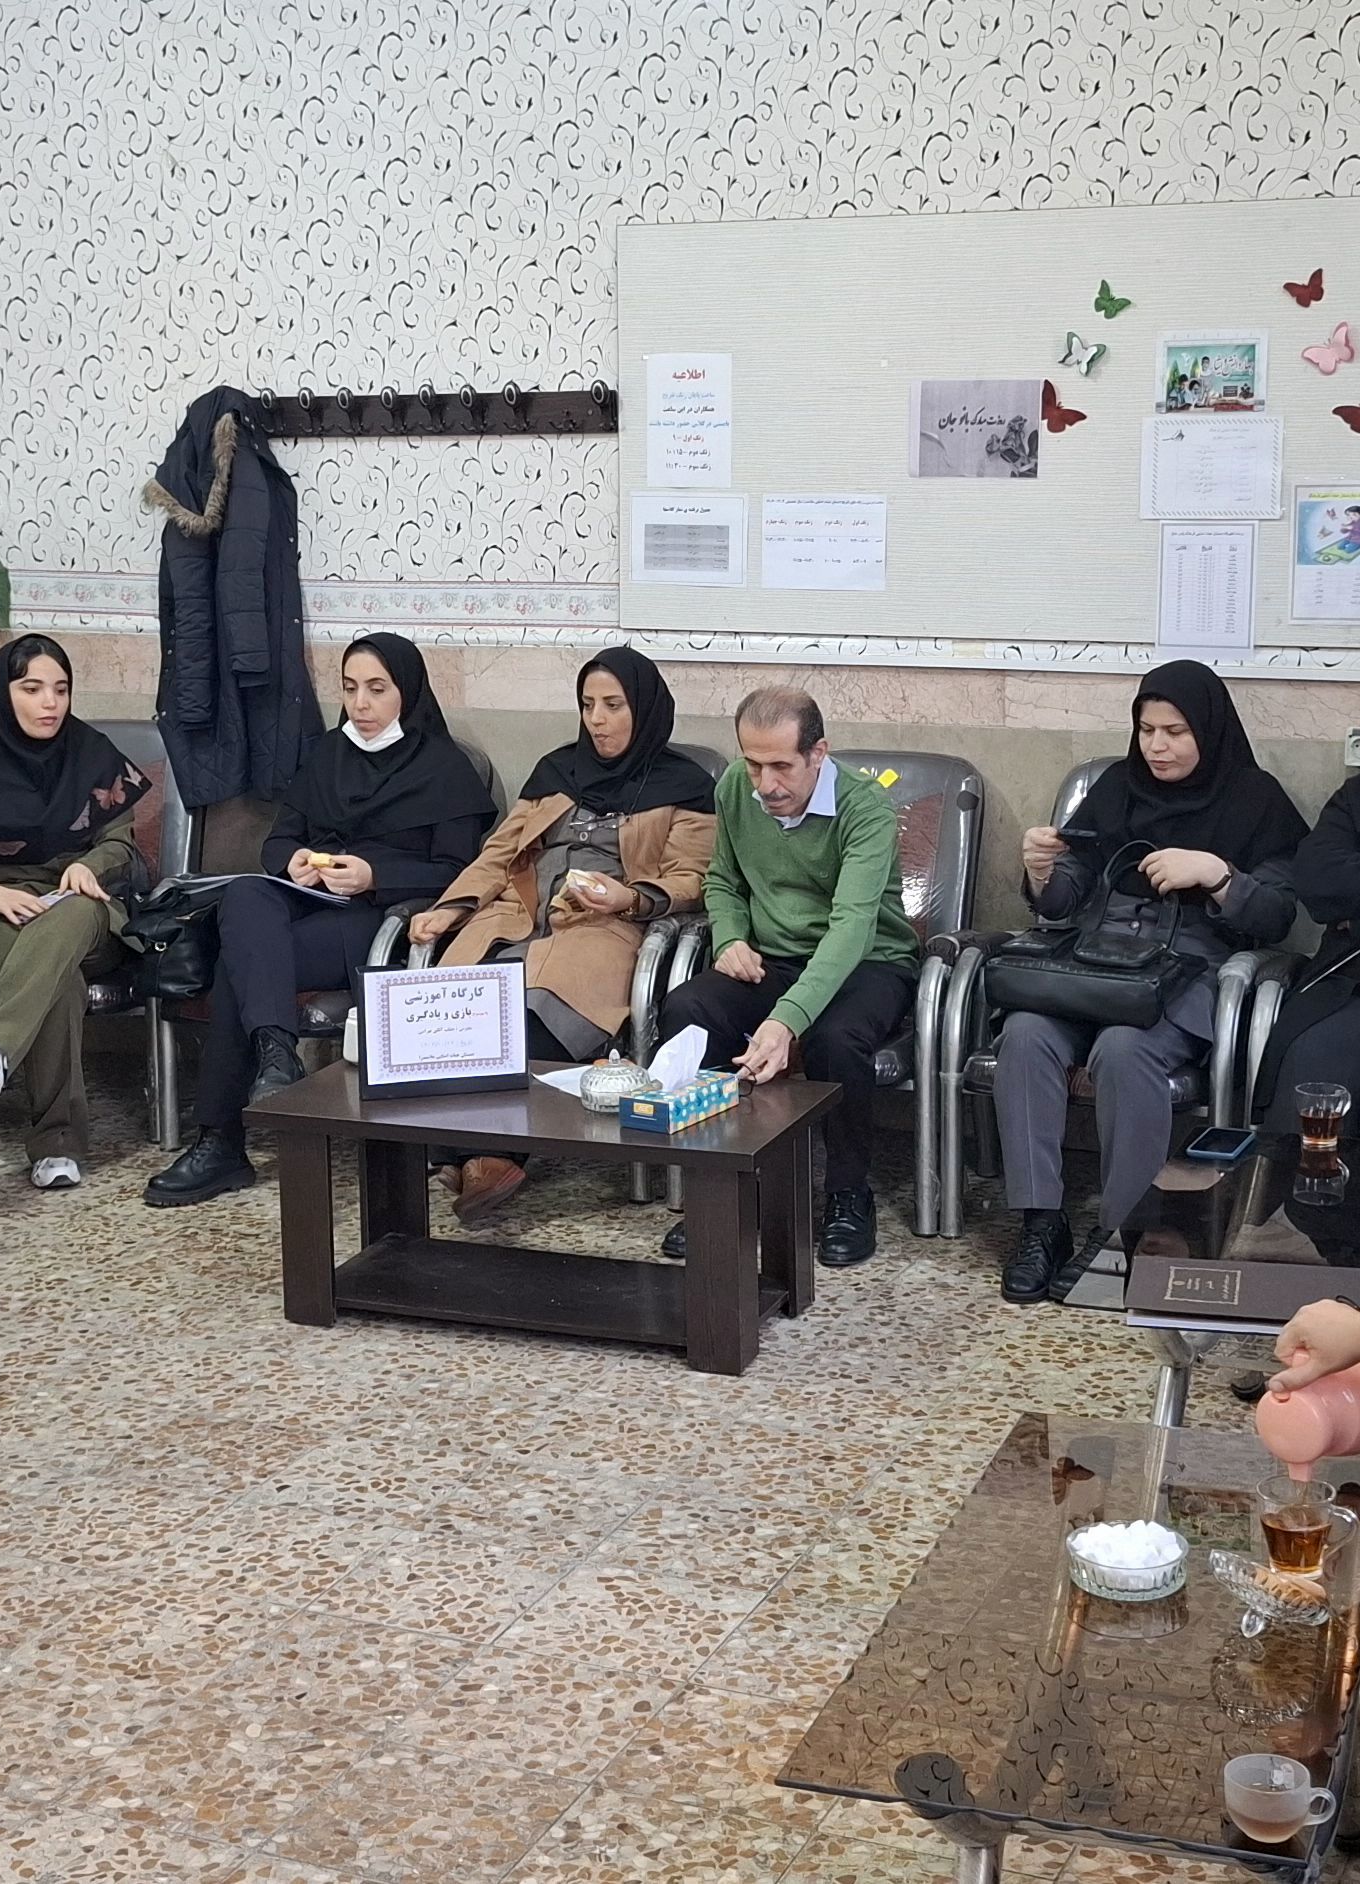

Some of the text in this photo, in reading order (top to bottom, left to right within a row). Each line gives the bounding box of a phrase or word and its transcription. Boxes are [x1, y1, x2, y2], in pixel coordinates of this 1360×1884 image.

[672, 369, 706, 383] اطلاعیه
[693, 405, 715, 414] همکاران
[938, 405, 1006, 433] روزت مبارک بانو جان
[683, 434, 693, 443] اول
[693, 435, 704, 443] زنگ
[688, 449, 699, 457] دوم
[699, 448, 711, 457] زنگ
[699, 463, 711, 471] زنگ
[404, 986, 485, 1005] کارگاه آموزشی
[406, 1008, 441, 1023] یادگیری
[443, 1012, 449, 1020] و
[450, 1007, 472, 1019] بازی
